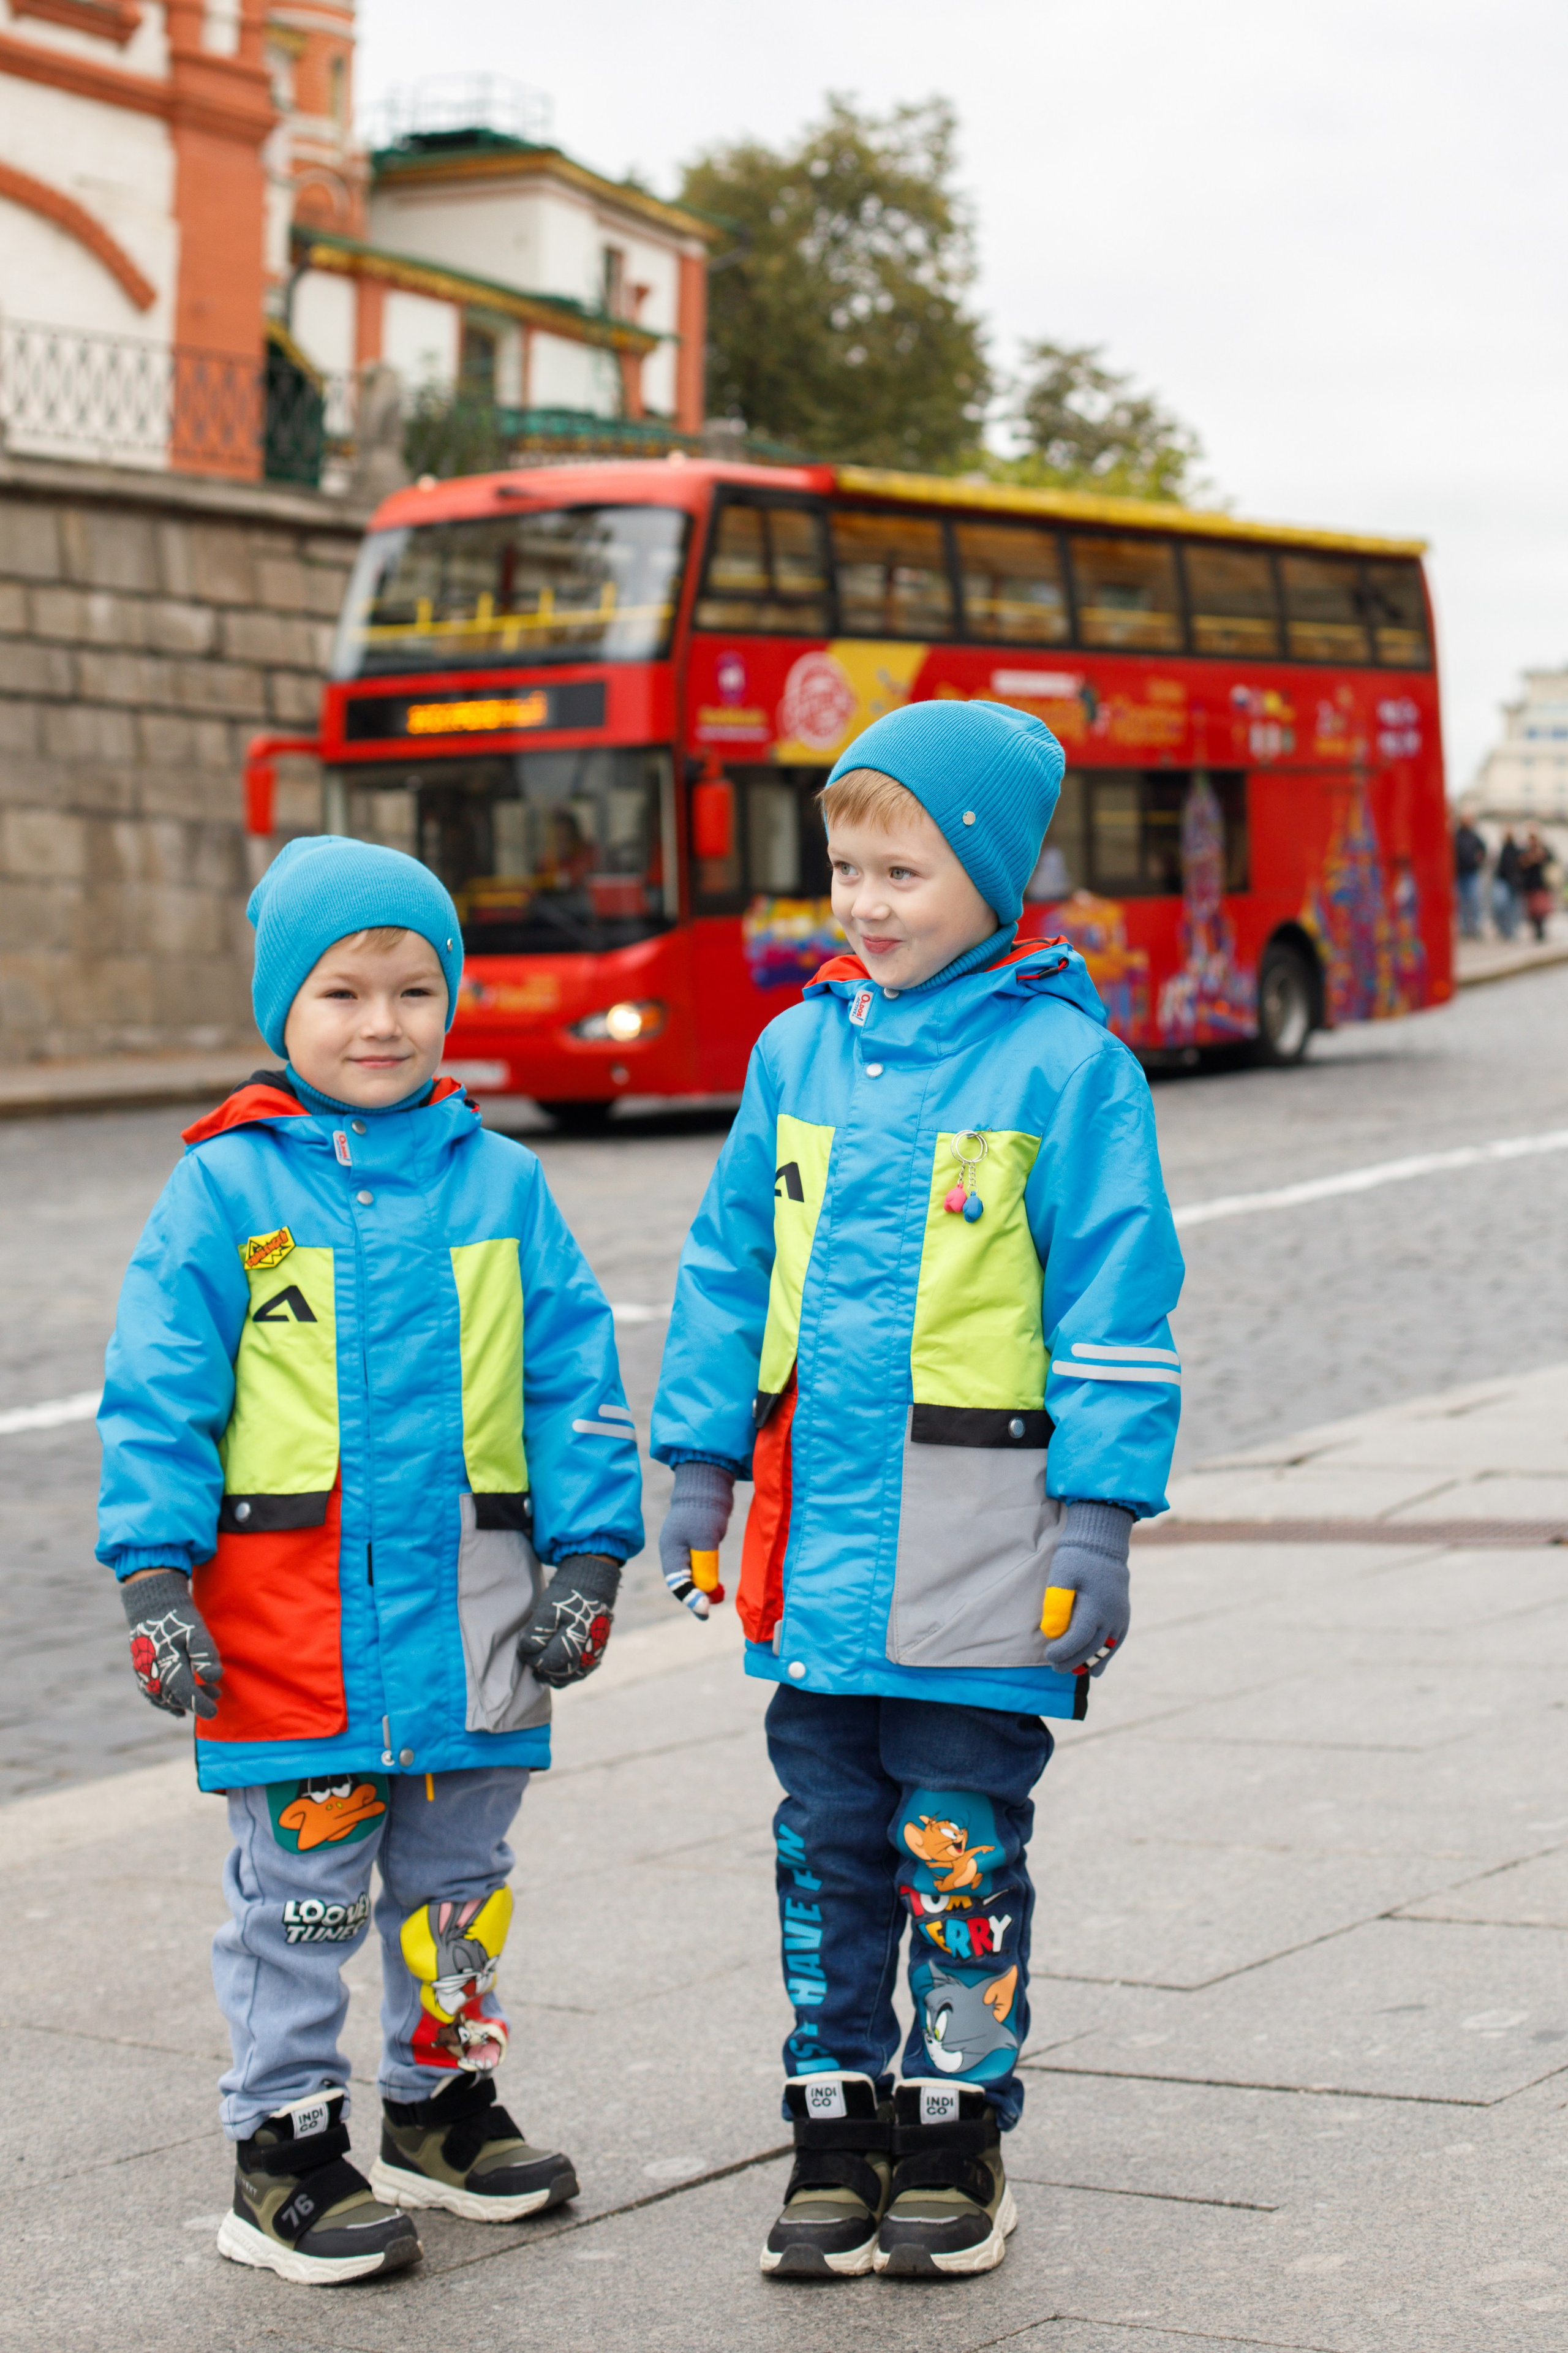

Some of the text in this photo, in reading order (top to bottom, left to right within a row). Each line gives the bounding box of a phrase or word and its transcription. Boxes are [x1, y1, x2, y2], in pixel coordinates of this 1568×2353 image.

[783, 1897, 827, 2006] HAVE
[811, 2087, 837, 2098] INDI
[927, 2096, 953, 2106] INDI
[299, 2107, 323, 2124] INDI
[282, 2194, 314, 2229] 76
